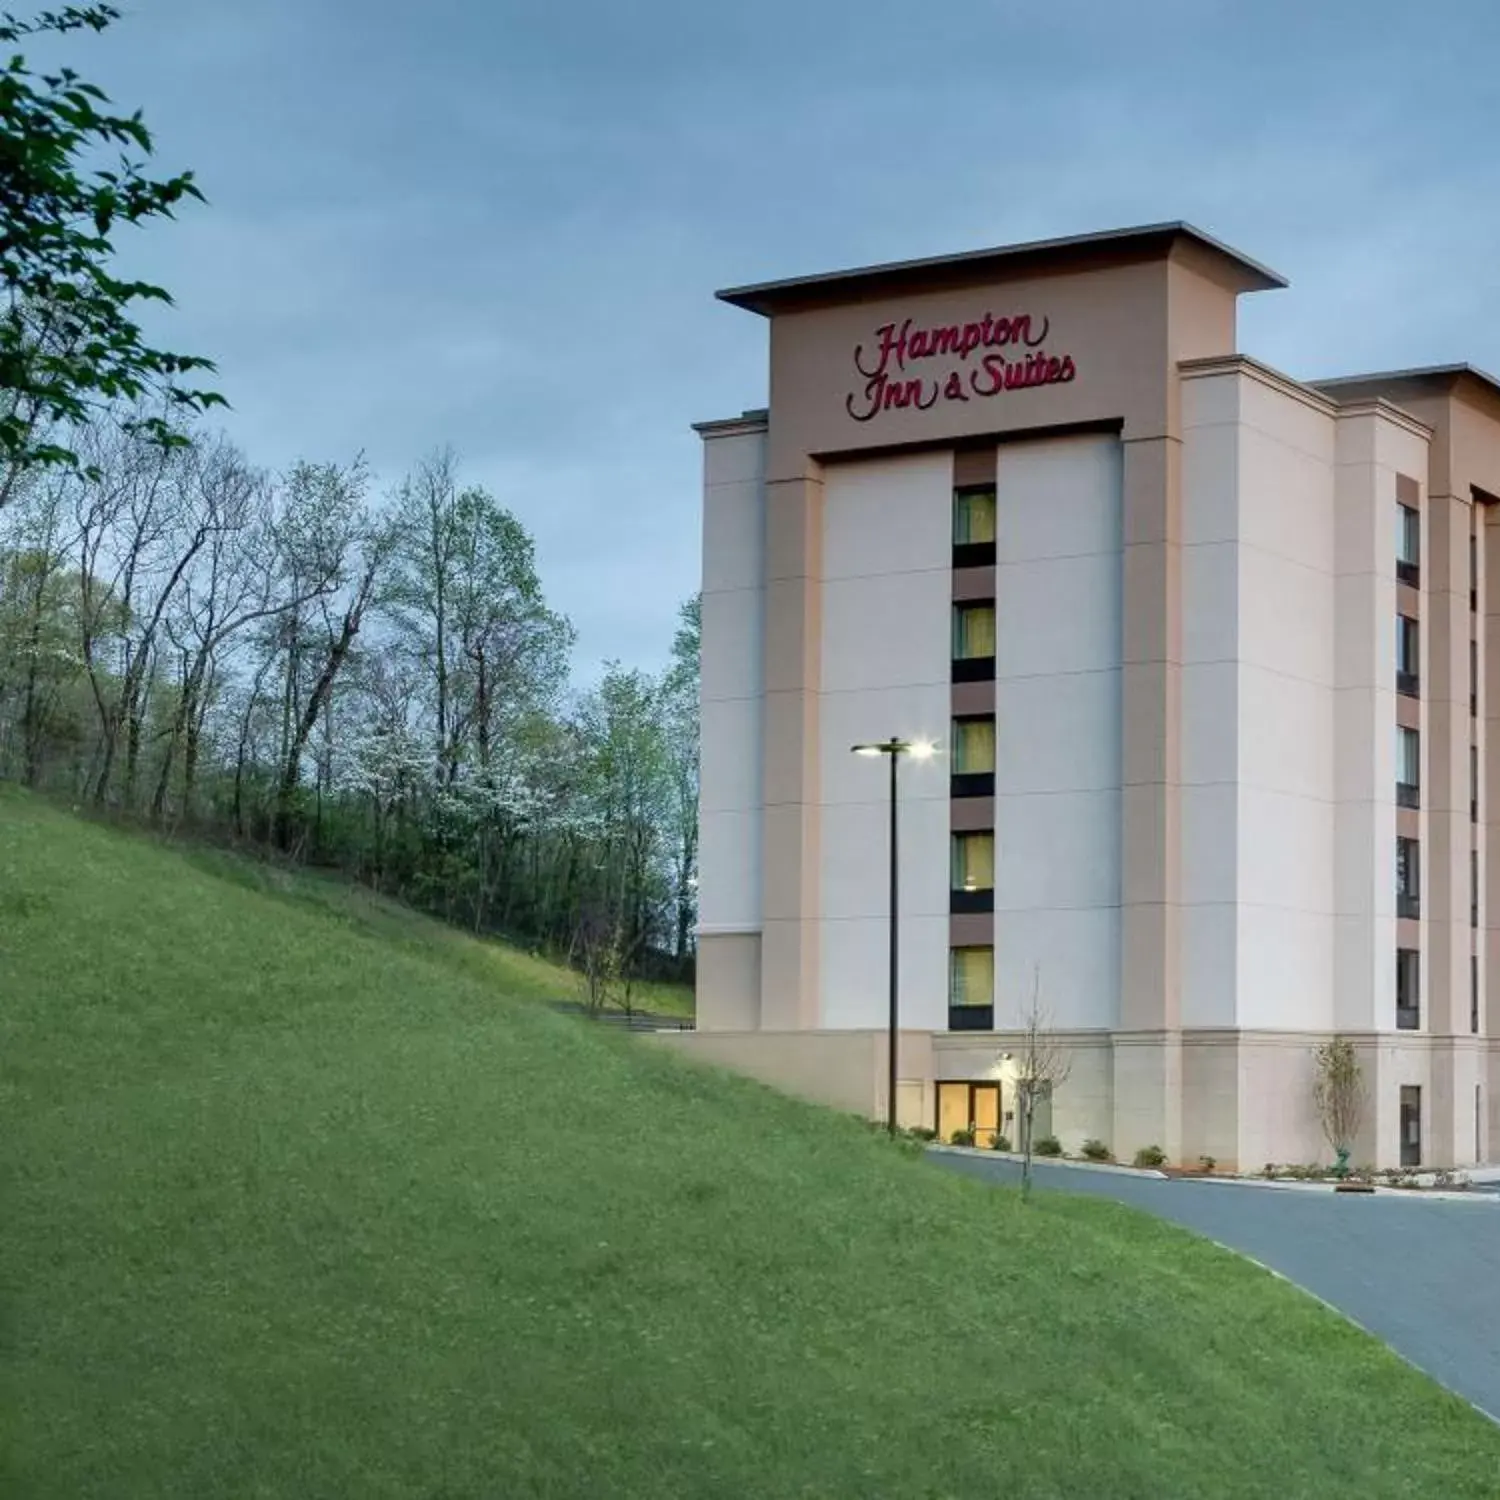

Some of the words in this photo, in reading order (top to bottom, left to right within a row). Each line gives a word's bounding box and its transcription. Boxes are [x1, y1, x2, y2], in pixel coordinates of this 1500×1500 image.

[854, 312, 1048, 378] Hampton
[846, 373, 938, 421] Inn
[944, 372, 969, 401] &
[971, 352, 1076, 396] Suites
